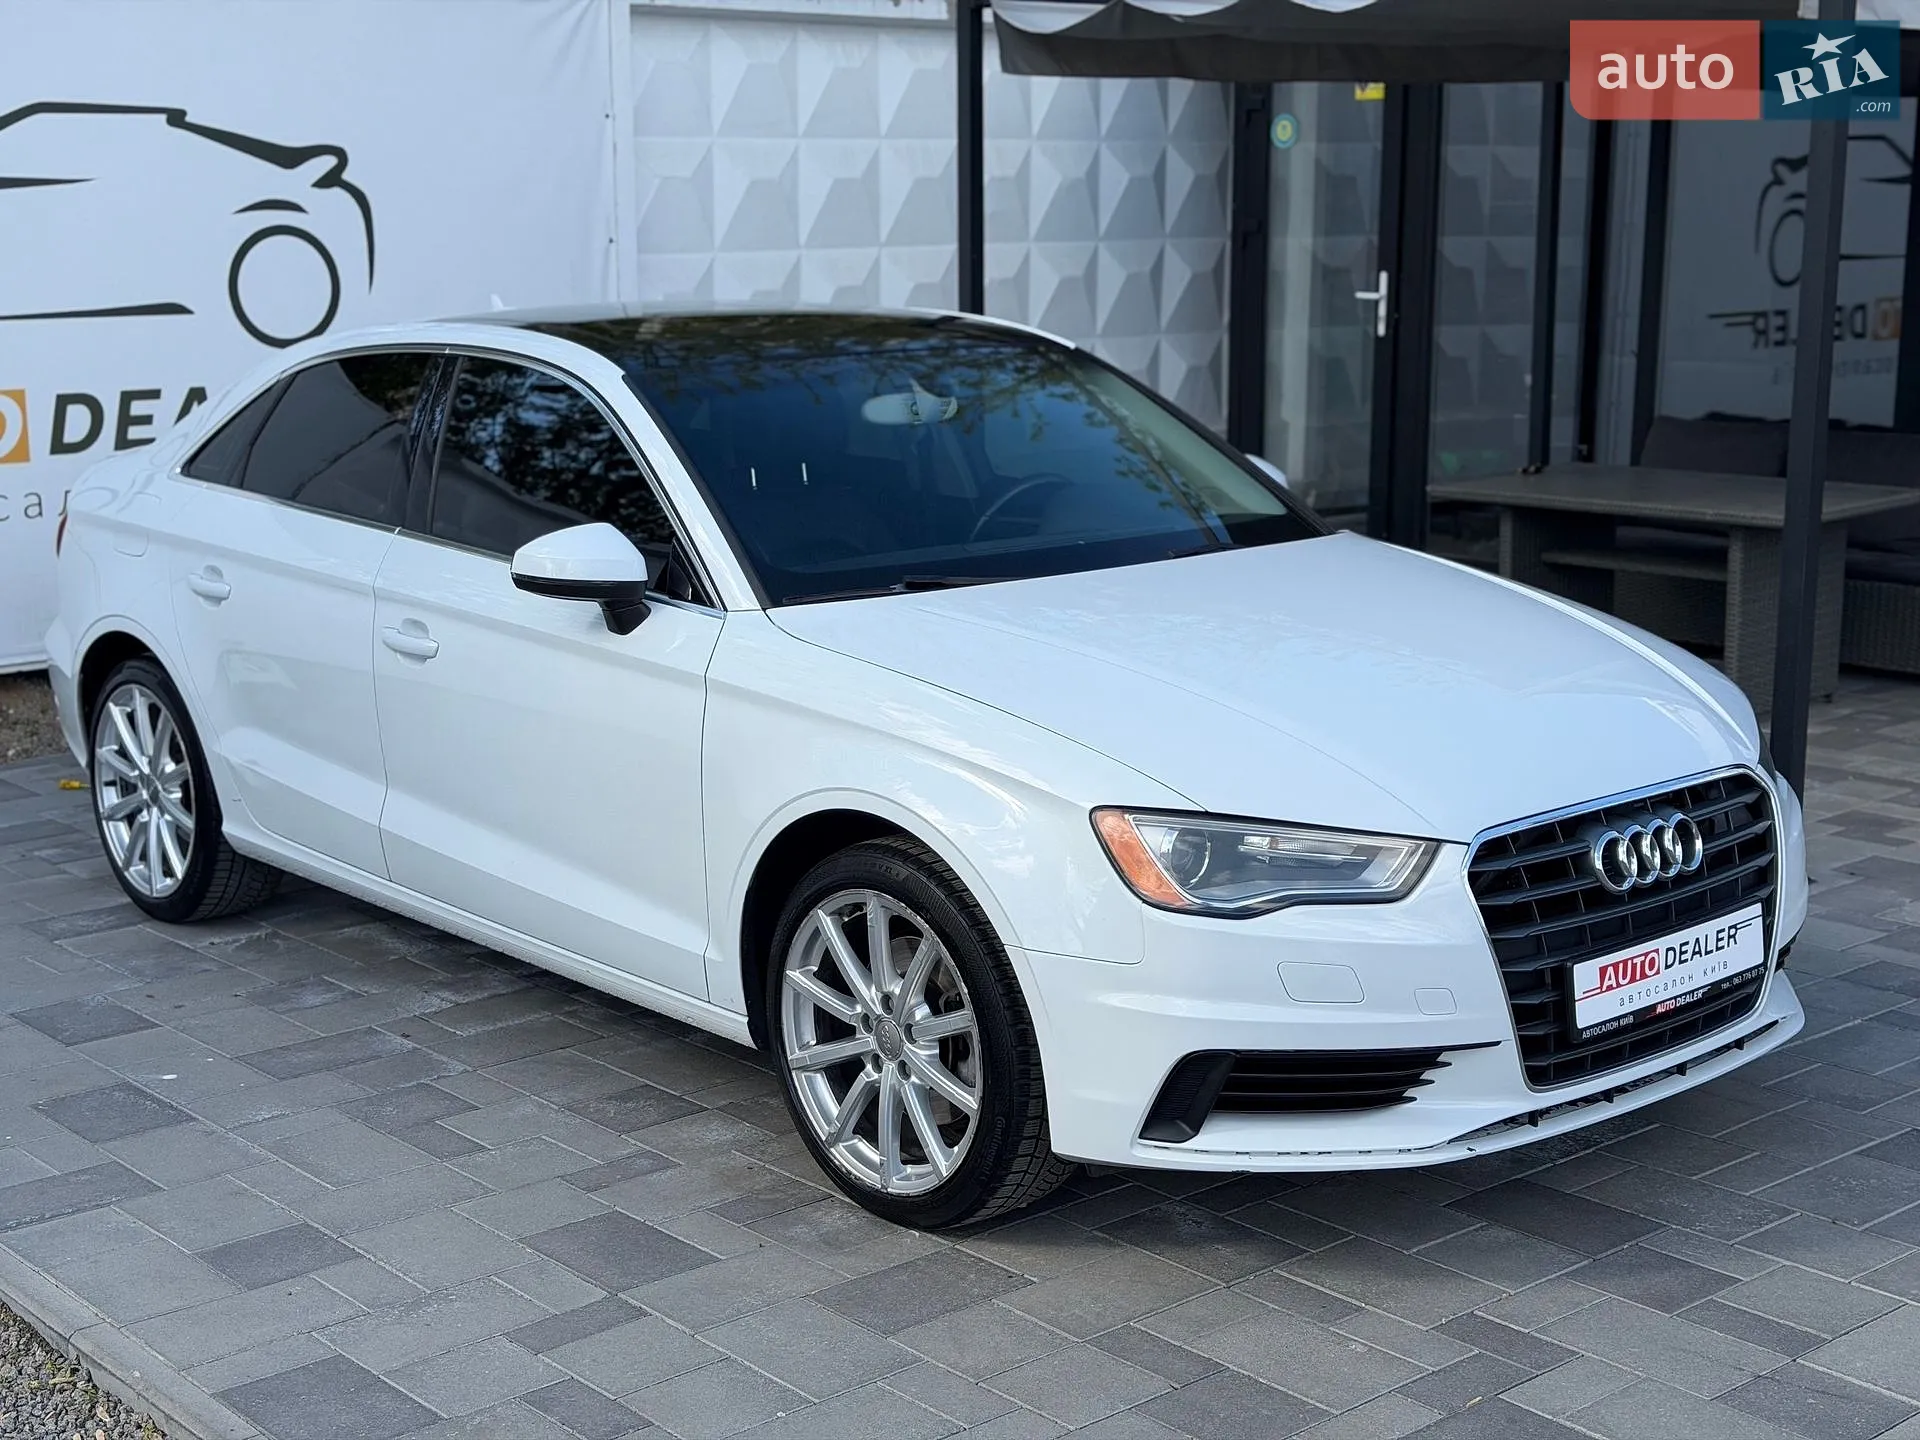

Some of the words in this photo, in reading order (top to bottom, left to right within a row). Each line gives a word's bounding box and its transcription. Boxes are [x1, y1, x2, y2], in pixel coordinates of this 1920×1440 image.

[1602, 951, 1660, 991] AUTO
[1664, 925, 1739, 970] DEALER
[1619, 974, 1695, 1007] автосалон
[1703, 960, 1729, 977] київ
[1656, 1000, 1676, 1014] AUTO
[1676, 989, 1704, 1007] DEALER
[1582, 1020, 1619, 1040] АВТОСАЛОН
[1619, 1014, 1634, 1029] КИЇВ
